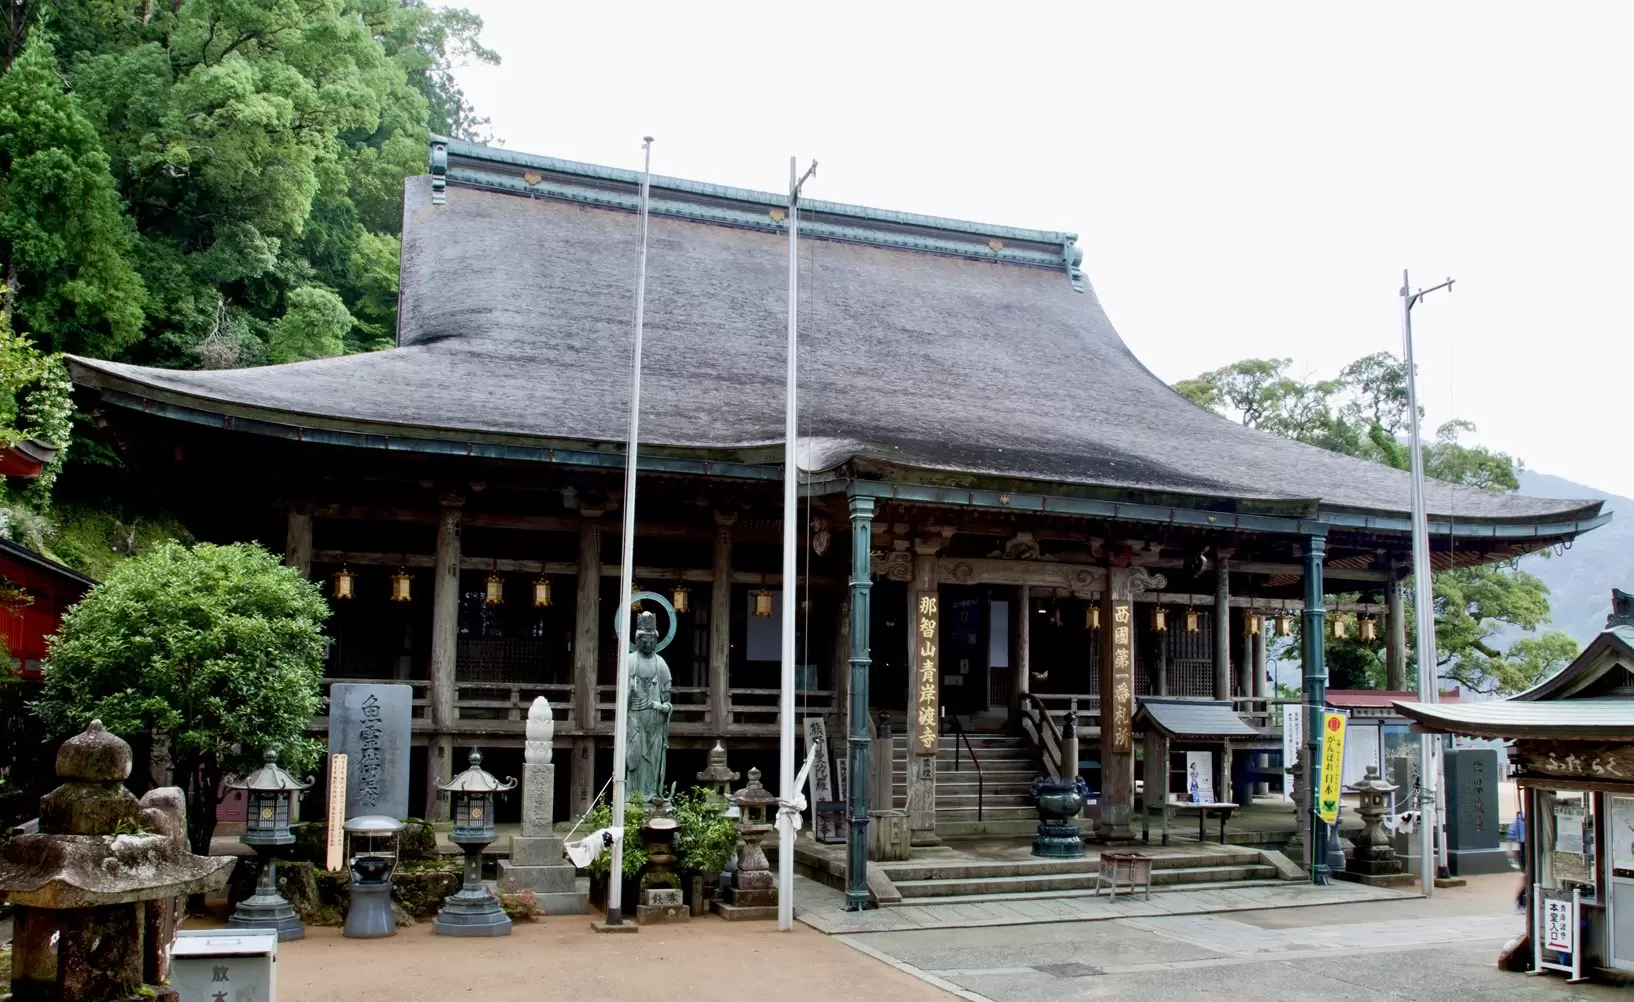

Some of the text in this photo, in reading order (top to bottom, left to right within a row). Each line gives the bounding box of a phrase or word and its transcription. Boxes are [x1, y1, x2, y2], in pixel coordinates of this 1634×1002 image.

[918, 596, 937, 749] 那智山青岸渡寺
[1114, 605, 1130, 748] 西國第一番札所
[1550, 903, 1559, 941] 本堂入口
